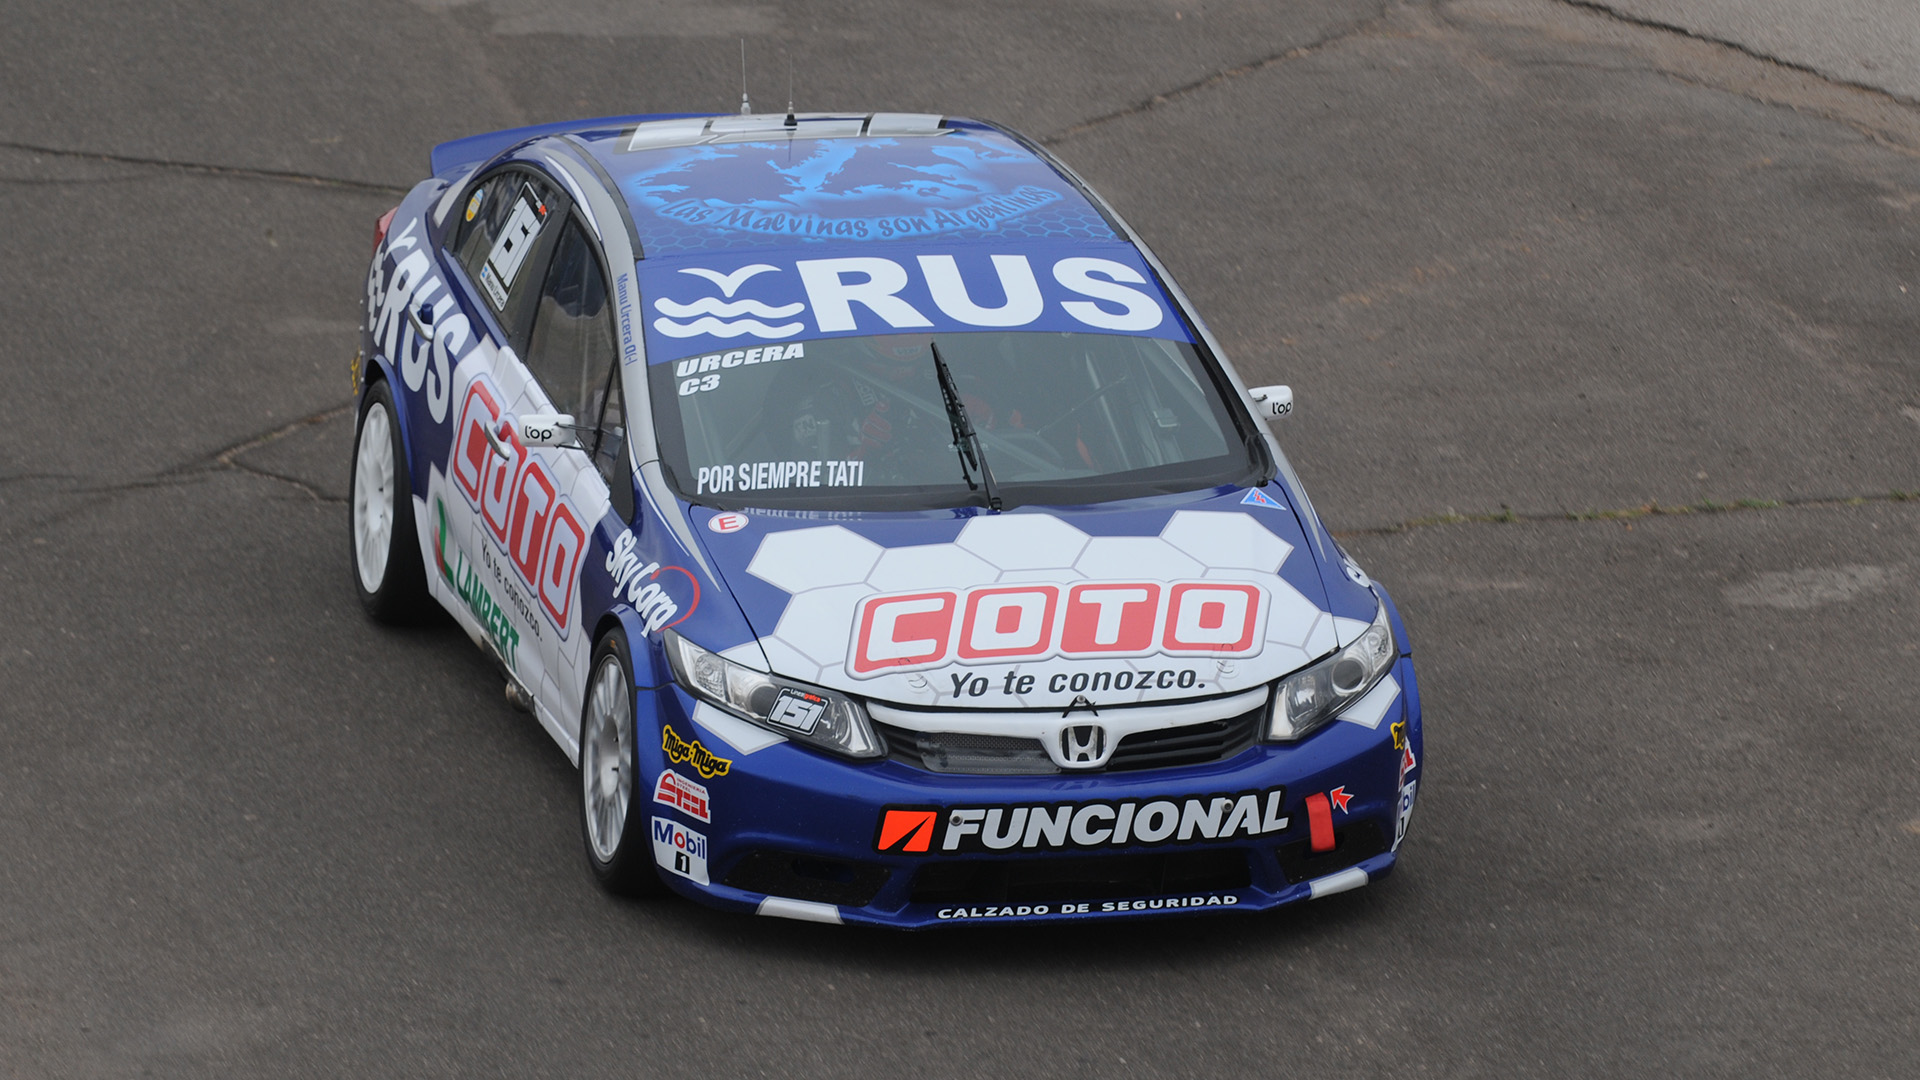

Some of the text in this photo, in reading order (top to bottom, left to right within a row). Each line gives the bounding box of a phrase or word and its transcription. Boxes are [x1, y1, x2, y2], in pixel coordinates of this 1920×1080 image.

[661, 187, 1058, 238] Las Malvinas son Argentinas
[617, 273, 629, 305] Manu
[795, 255, 1164, 333] RUS
[620, 304, 633, 345] Urcera
[676, 343, 804, 377] URCERA
[679, 374, 721, 396] C3
[697, 461, 864, 495] POR SIEMPRE TATI
[718, 516, 739, 530] E
[493, 557, 502, 583] te
[456, 550, 519, 673] LAMBERT
[854, 583, 1260, 673] COTO
[950, 669, 1206, 698] Yo te conozco.
[770, 695, 823, 731] 151
[942, 791, 1289, 850] FUNCIONAL
[654, 820, 706, 860] Mobil
[938, 895, 1238, 919] CALZADO DE SEGURIDAD
